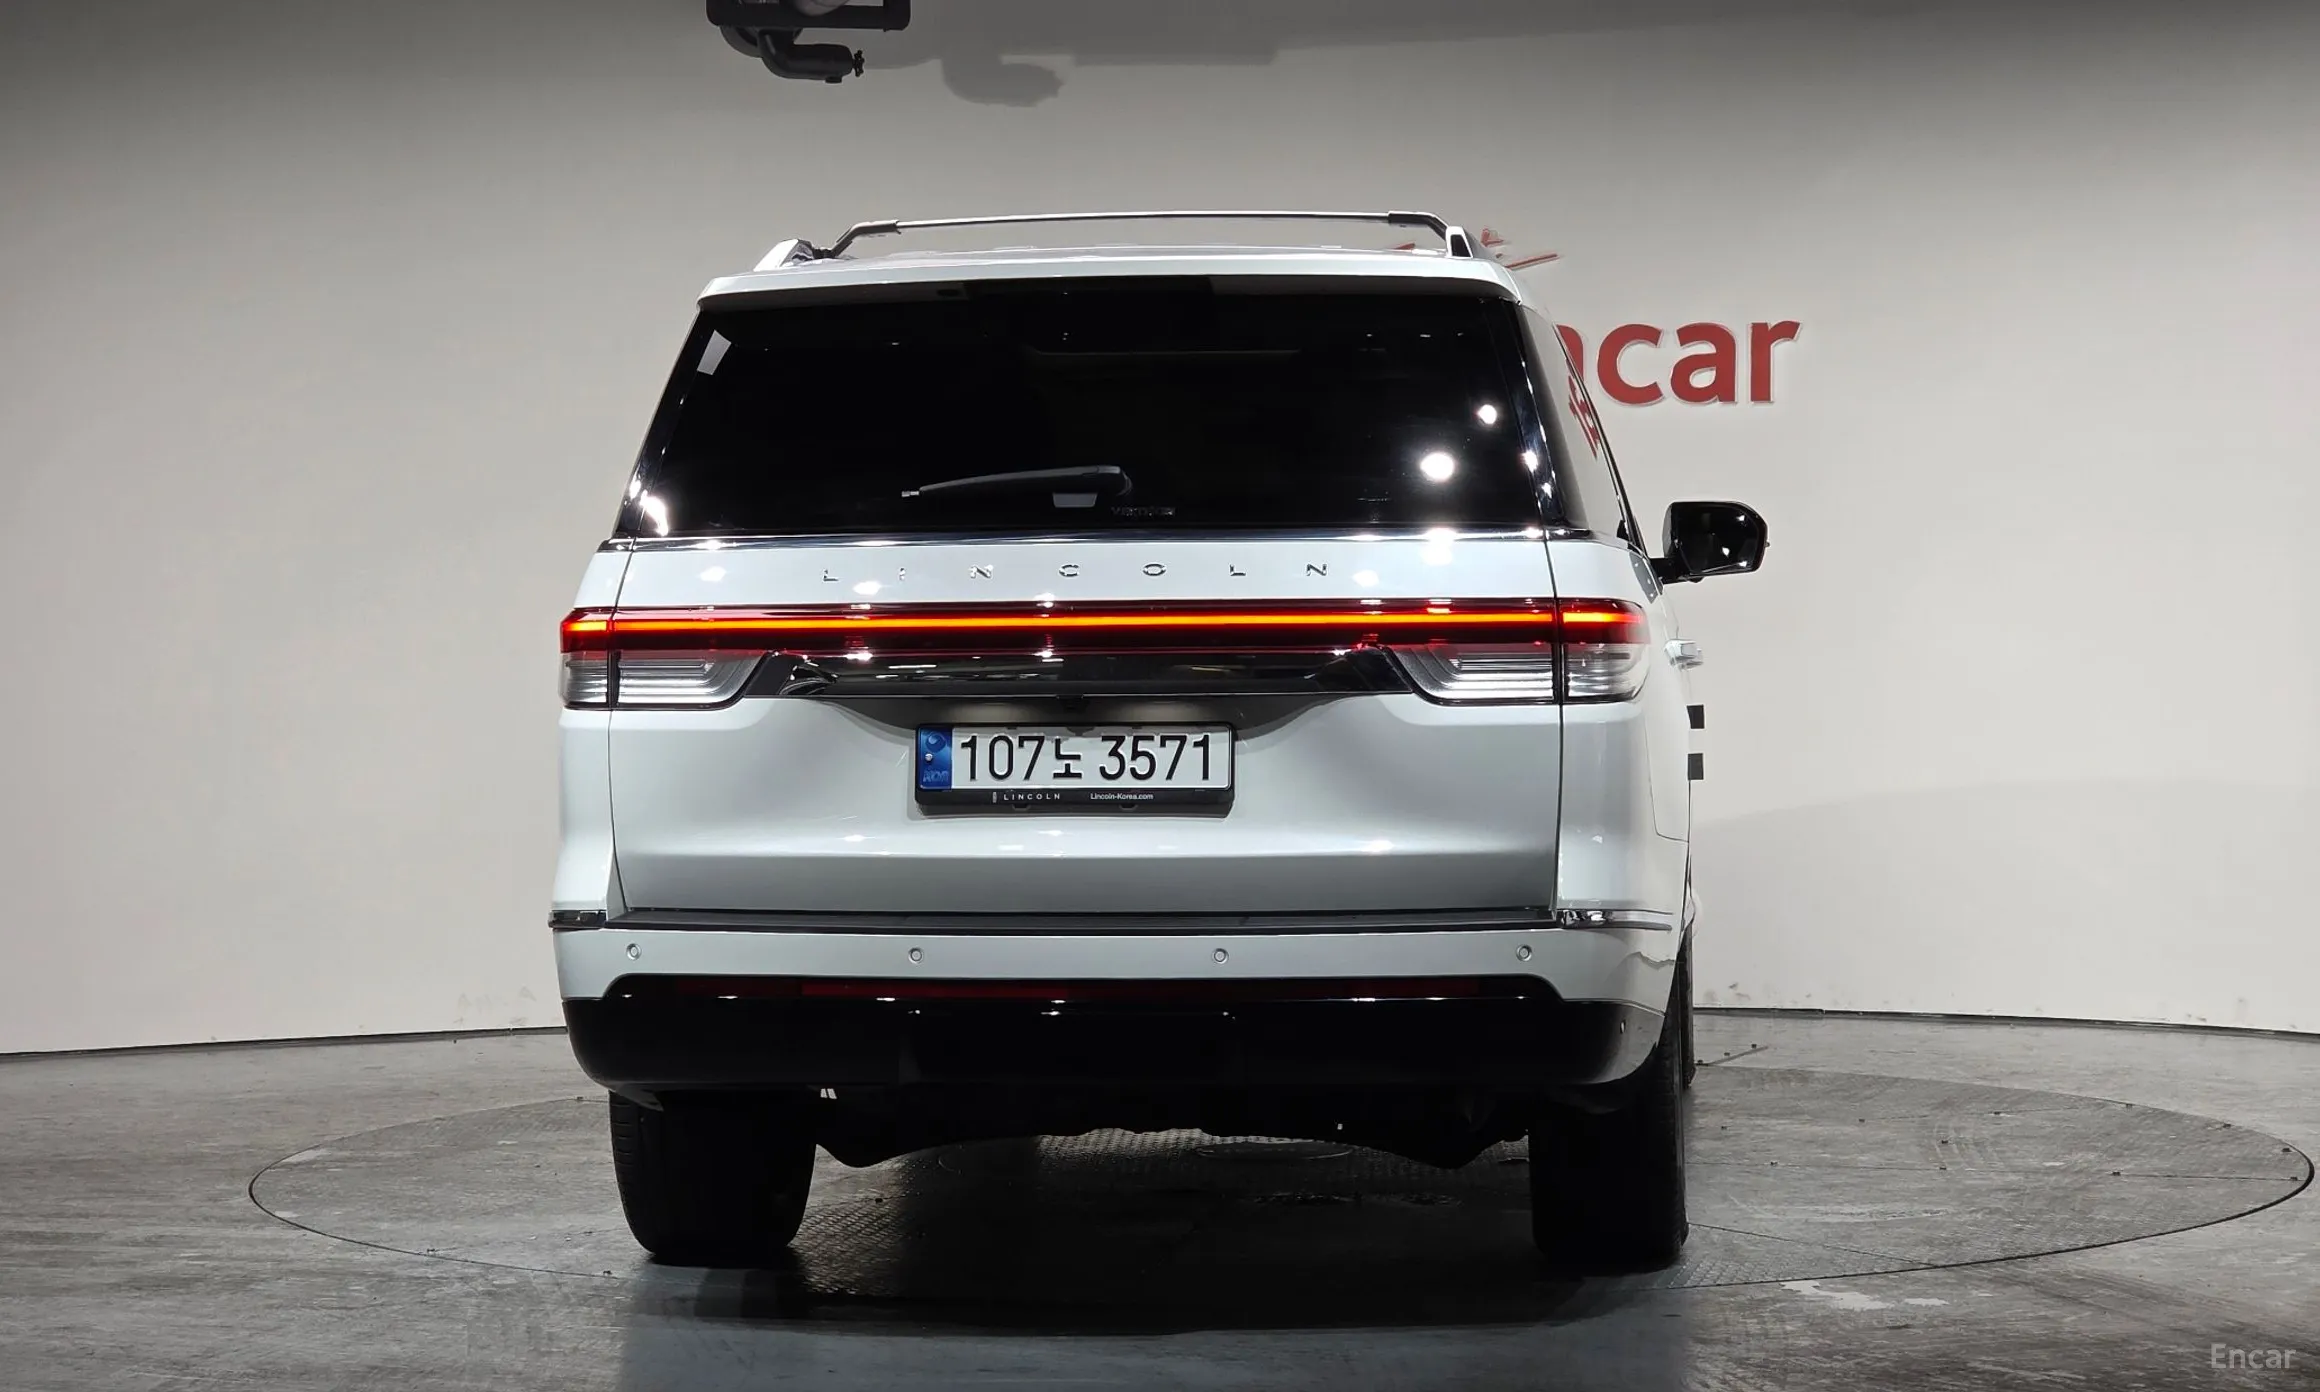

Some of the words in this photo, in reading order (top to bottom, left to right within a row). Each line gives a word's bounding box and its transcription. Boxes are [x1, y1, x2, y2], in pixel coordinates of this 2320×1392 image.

[822, 562, 1328, 582] LINCOLN
[960, 734, 1083, 781] 107노
[1099, 734, 1211, 781] 3571
[1003, 793, 1061, 801] LINCOLN
[1090, 792, 1154, 800] Lincoln-Korea.com
